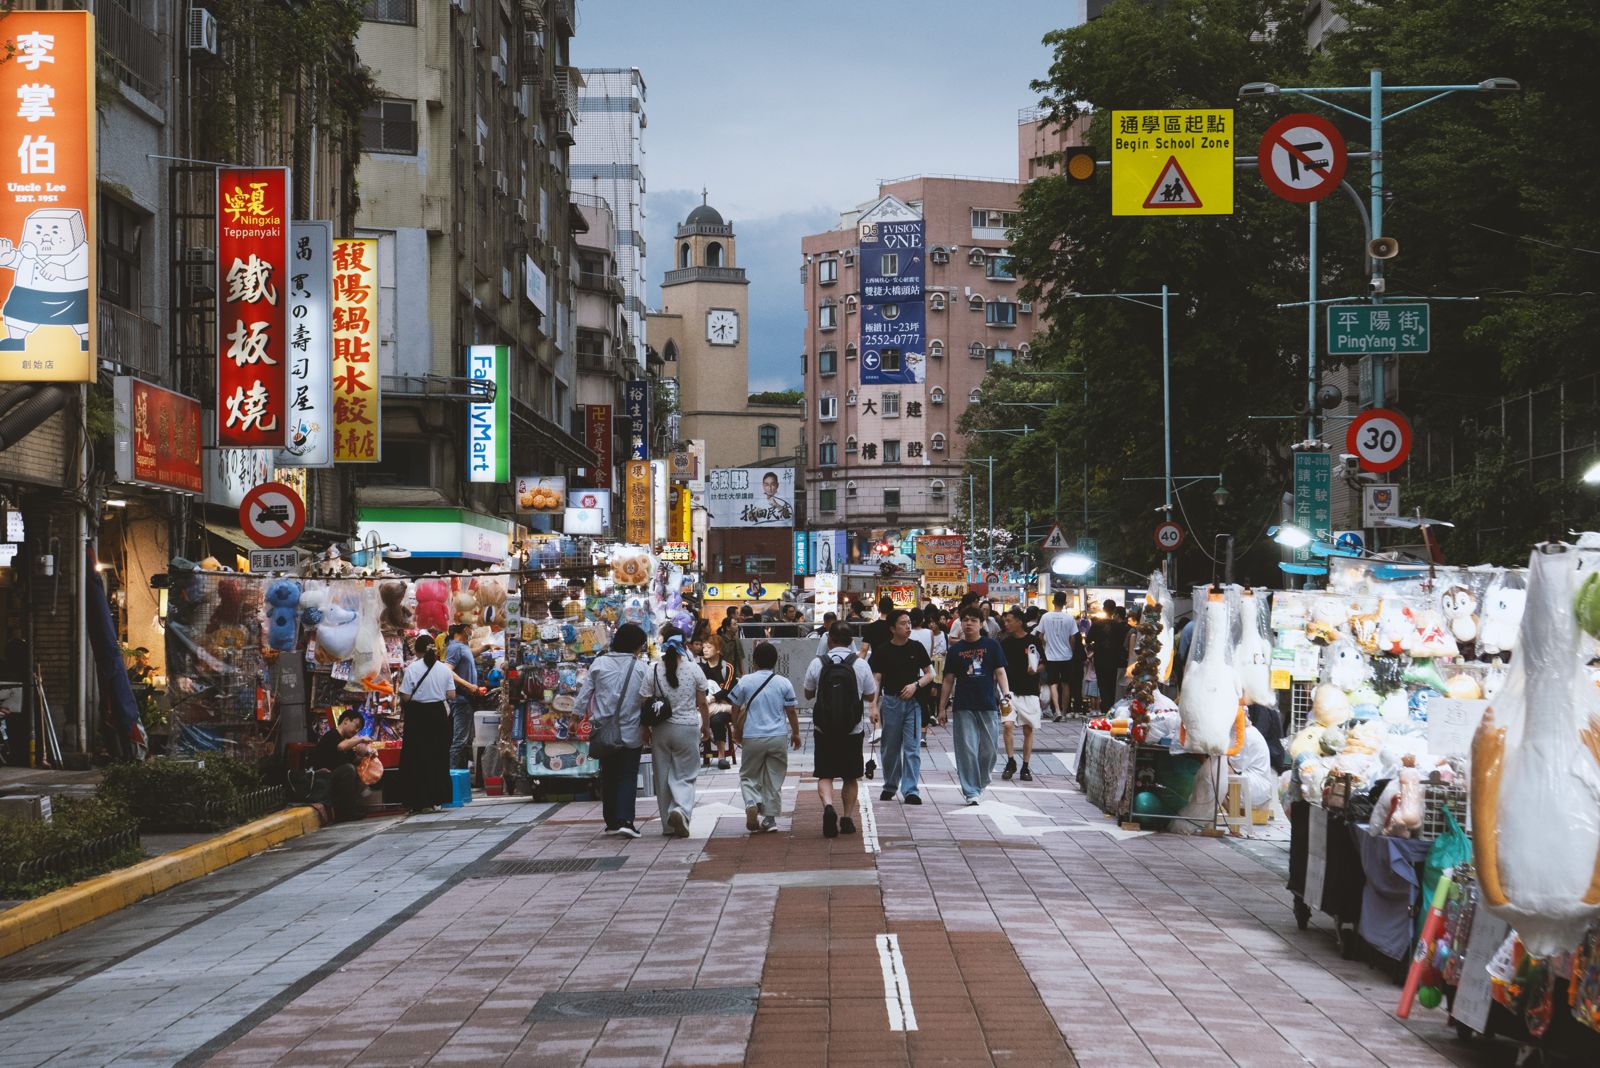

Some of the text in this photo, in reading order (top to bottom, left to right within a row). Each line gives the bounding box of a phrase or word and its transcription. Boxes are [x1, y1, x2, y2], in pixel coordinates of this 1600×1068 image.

[17, 31, 55, 174] 李掌伯
[1120, 115, 1225, 134] 通學區起點
[1115, 137, 1230, 152] Begin School Zone
[7, 182, 67, 192] Uncle Lee
[240, 216, 281, 227] Ningxia
[888, 223, 921, 234] VISION
[224, 227, 281, 239] Teppanyaki
[865, 285, 920, 297] 雙捷大橋頭站
[1337, 310, 1420, 333] 平陽街
[333, 241, 374, 424] 馥陽鍋貼水餃
[865, 334, 920, 346] 2552-0777
[226, 253, 277, 432] 鐵板燒
[1338, 335, 1397, 352] PingYang
[22, 360, 54, 370] 創始店
[861, 398, 878, 461] 大樓
[906, 400, 924, 459] 建設
[1363, 427, 1397, 452] 30
[1297, 469, 1311, 561] 請走左側道
[1160, 531, 1178, 541] 40
